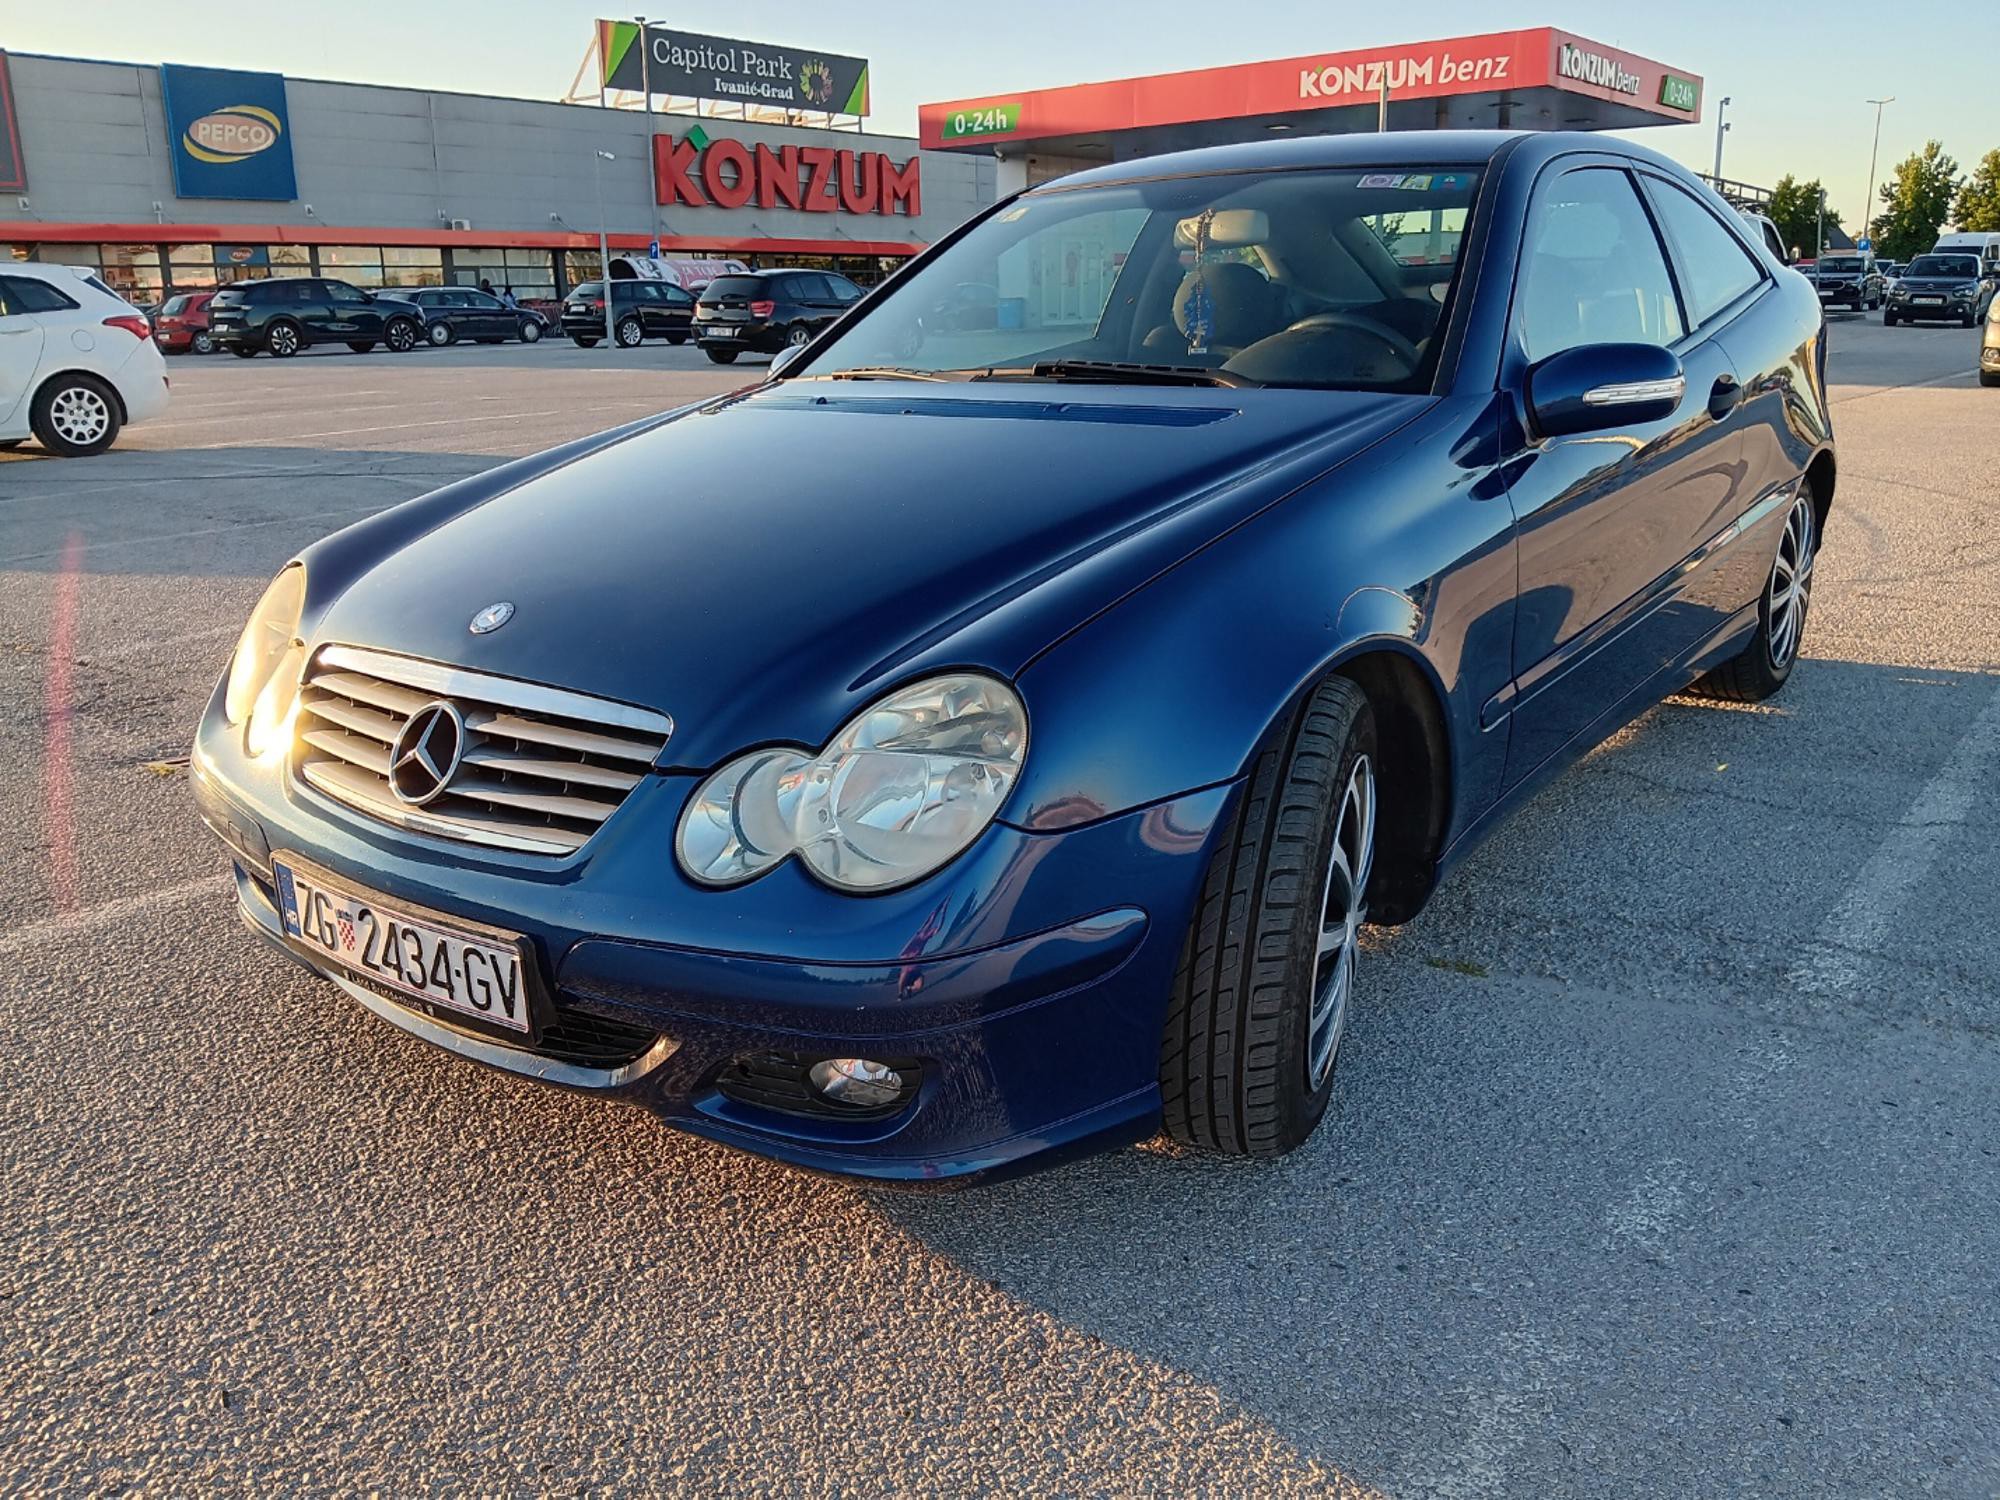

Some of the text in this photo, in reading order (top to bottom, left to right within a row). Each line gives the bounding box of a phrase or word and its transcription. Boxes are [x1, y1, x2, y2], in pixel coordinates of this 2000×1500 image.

[653, 38, 793, 80] Capitol Park
[1300, 53, 1510, 98] KONZUM benz
[1561, 45, 1640, 95] KONZUM benz
[714, 77, 794, 100] Ivanić-Grad
[1669, 81, 1693, 108] 0-24h
[198, 122, 266, 144] PEPCO
[954, 108, 1008, 134] 0-24h
[653, 132, 922, 218] KONZUM
[286, 907, 299, 928] HR
[296, 880, 337, 951] ZG
